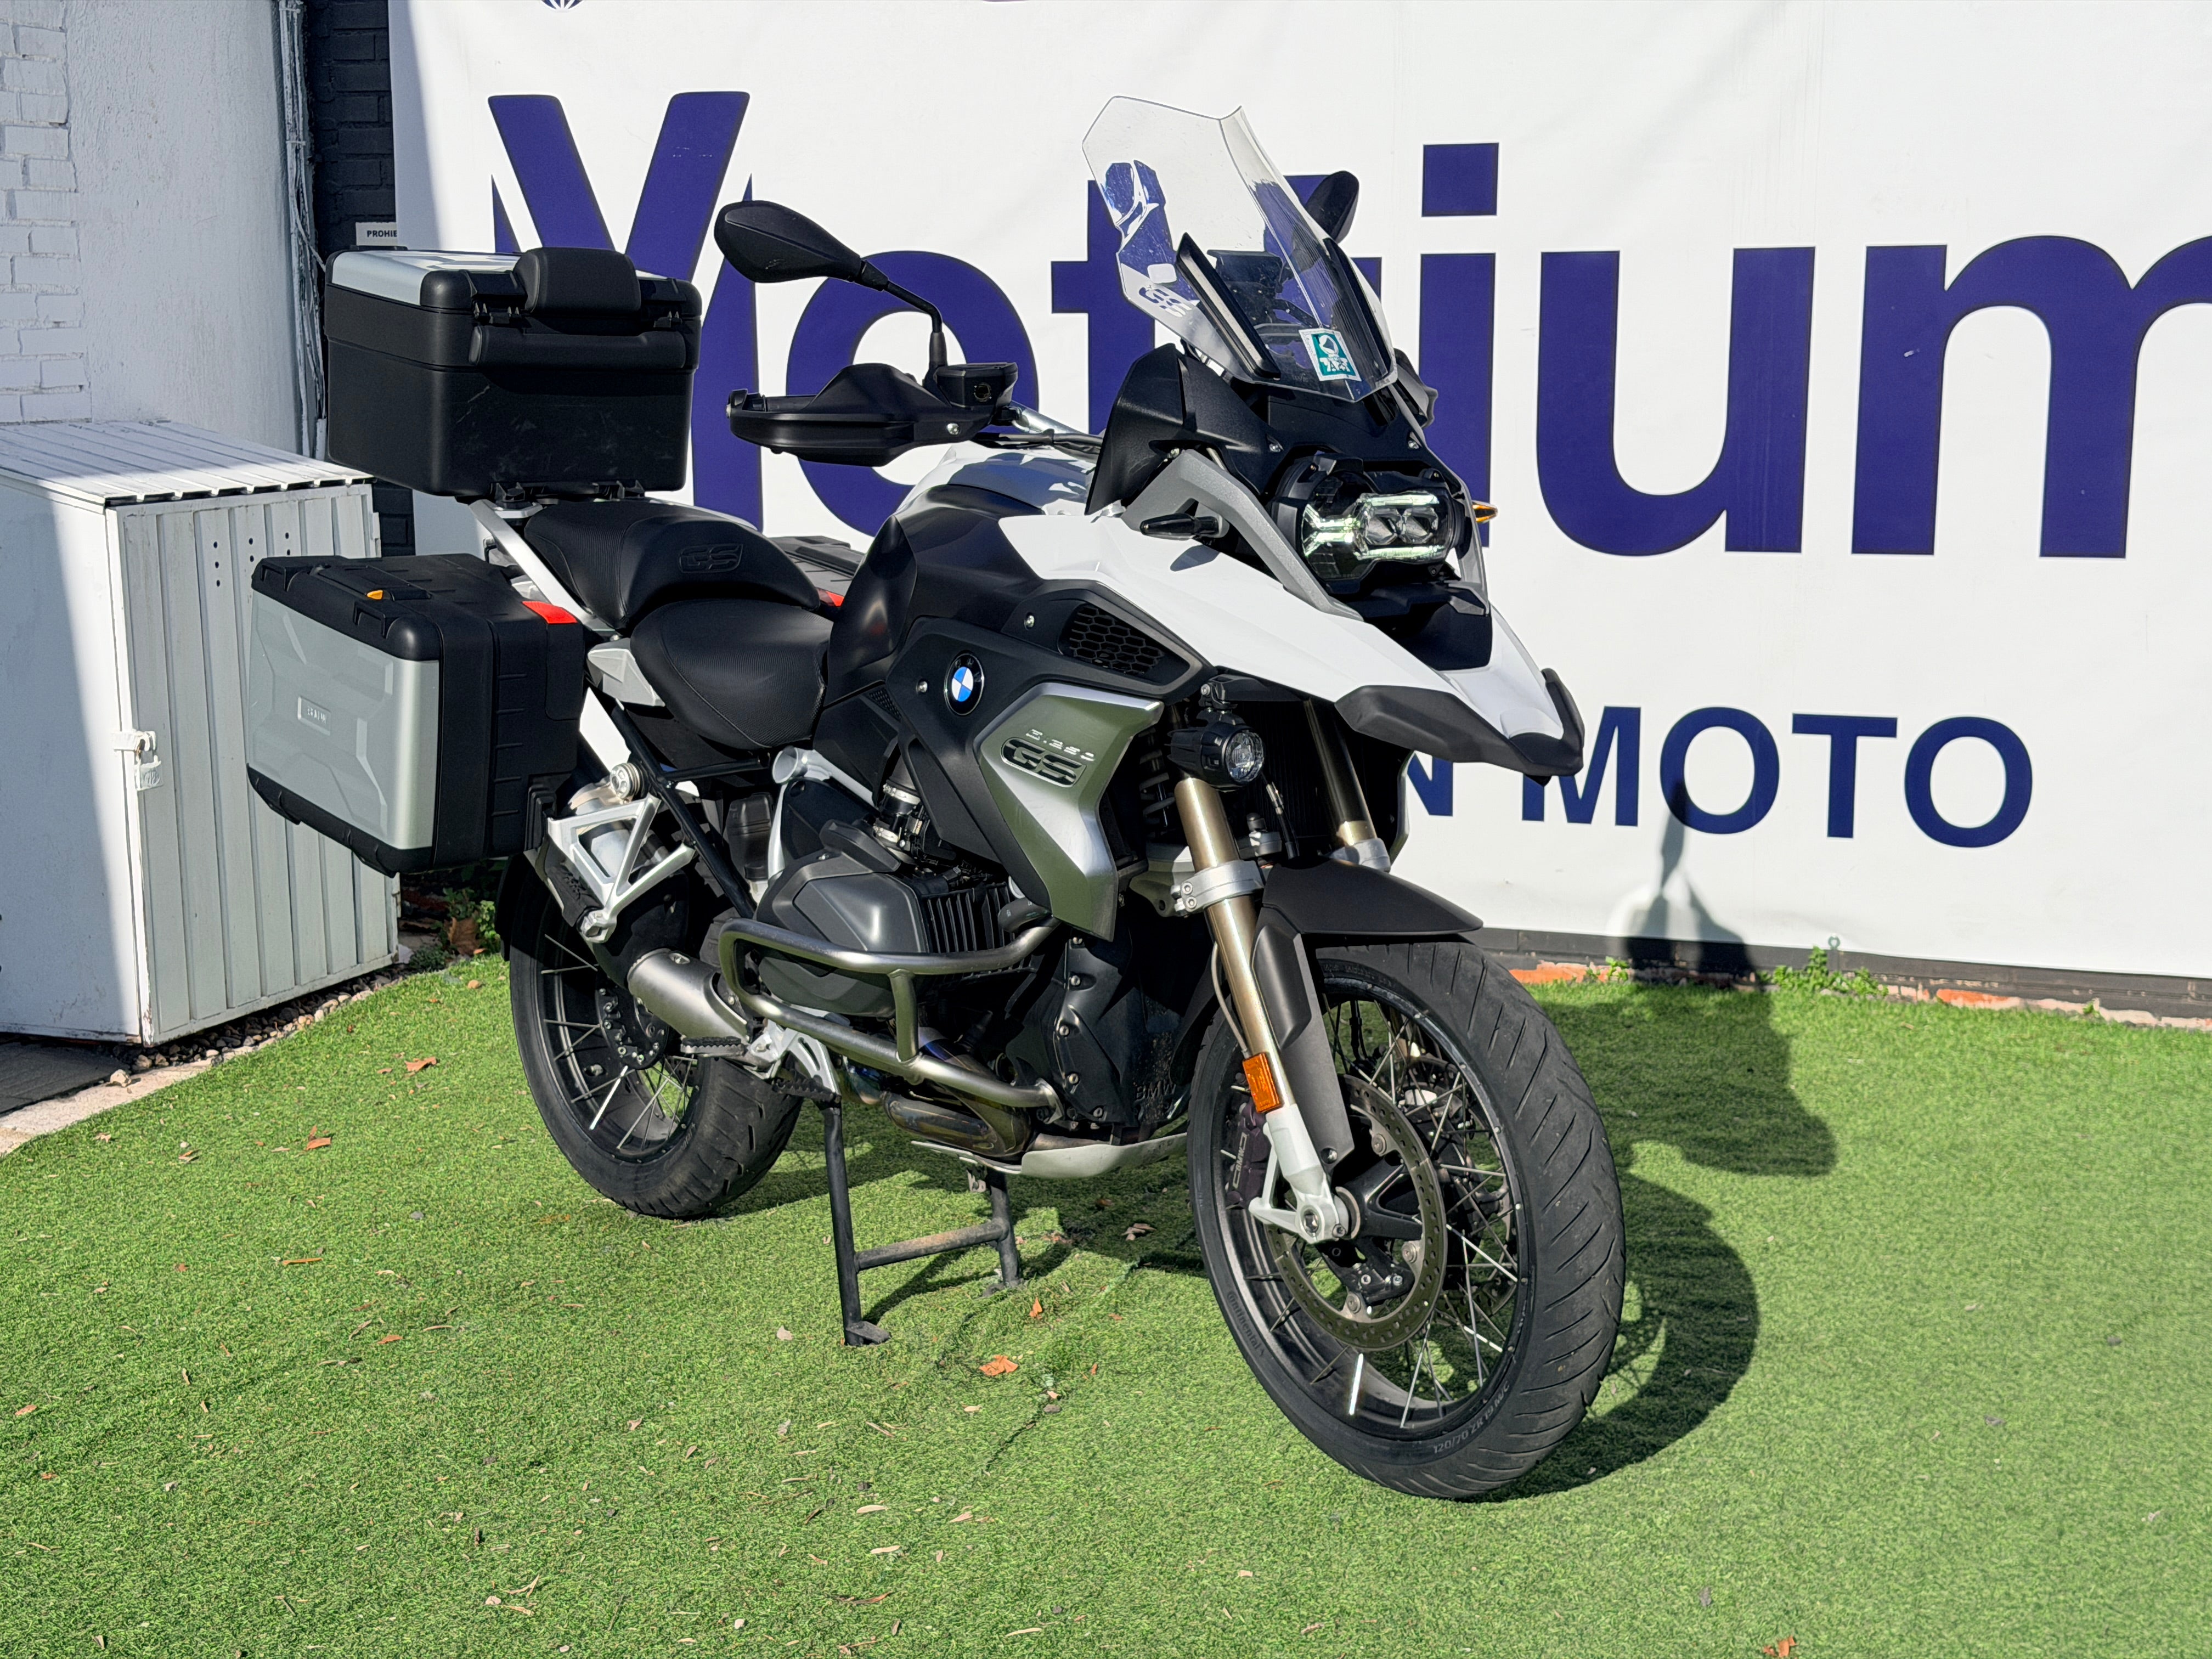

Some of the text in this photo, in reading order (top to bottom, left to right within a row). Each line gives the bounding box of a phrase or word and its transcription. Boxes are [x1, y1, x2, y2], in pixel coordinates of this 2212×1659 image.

[679, 543, 743, 573] GS
[1002, 738, 1084, 786] GS
[1522, 706, 2033, 848] MOTO
[1434, 1431, 1469, 1454] 120/70
